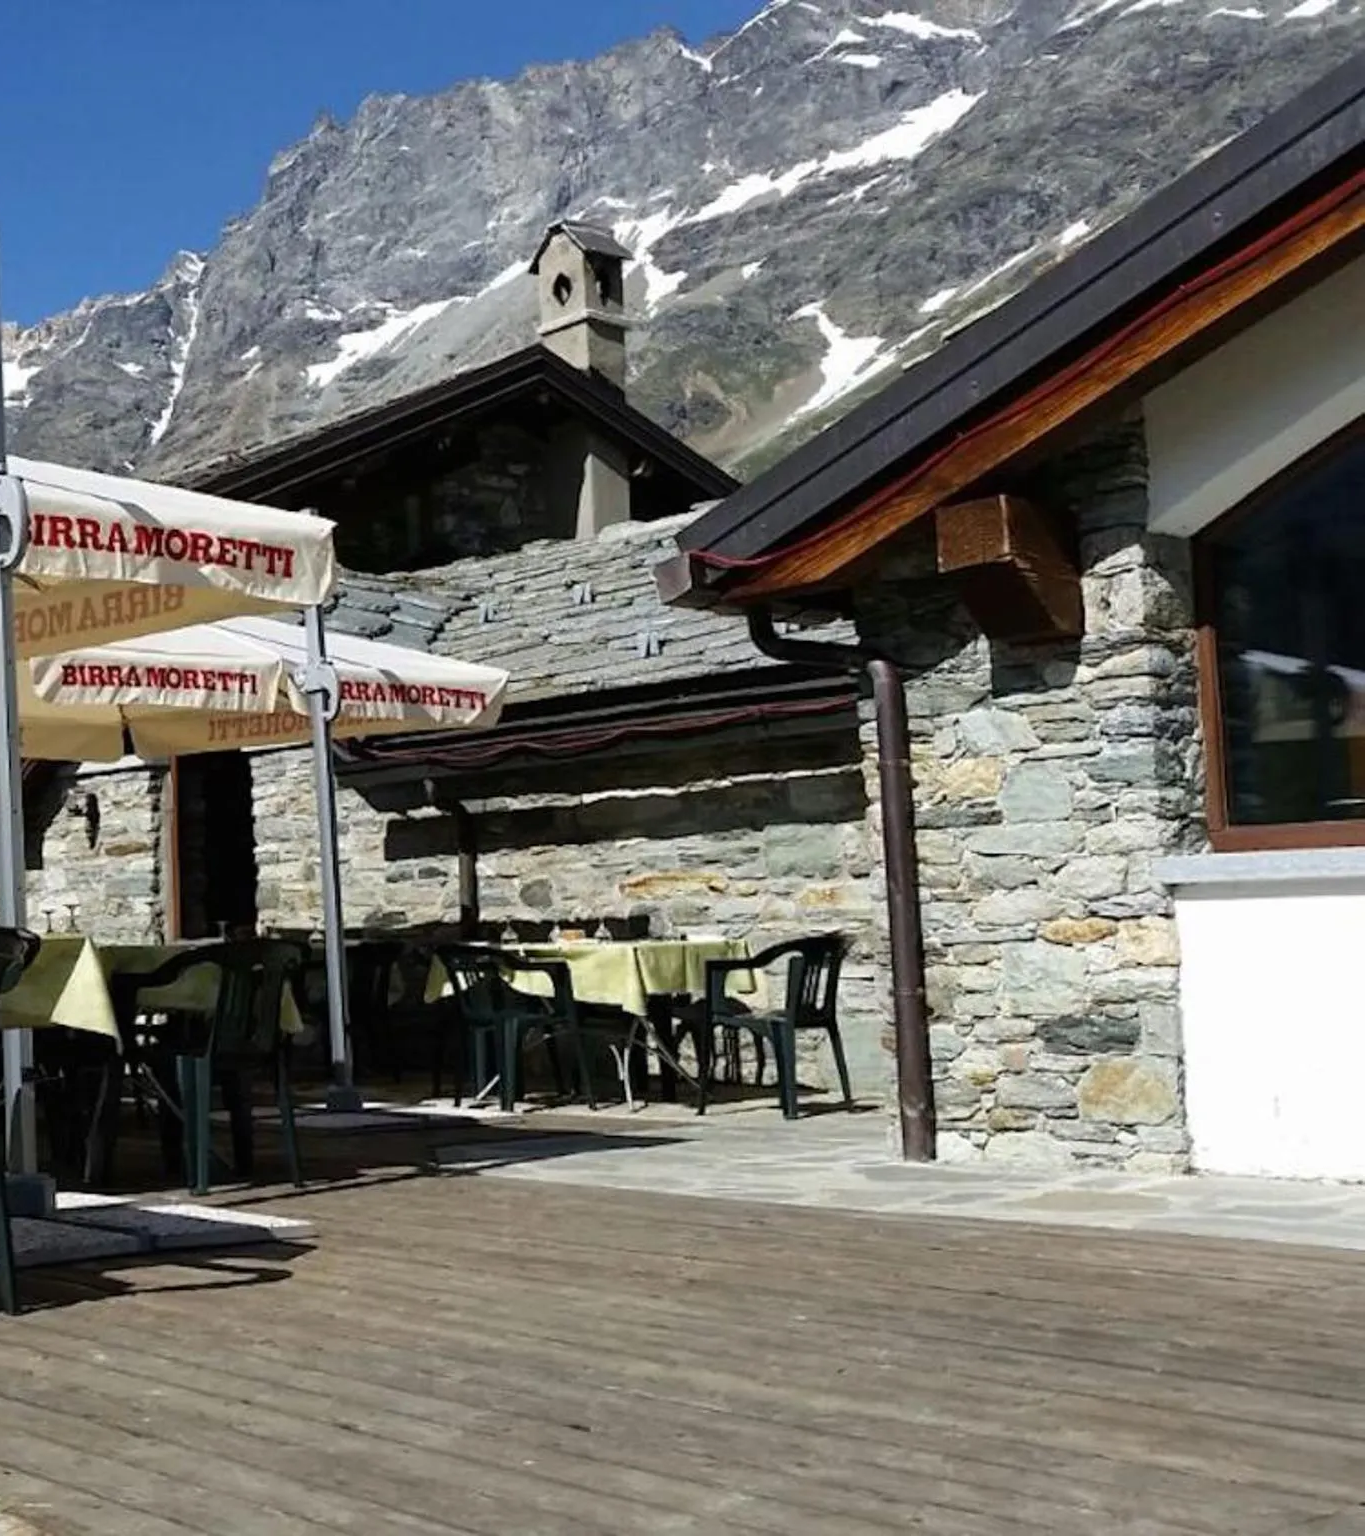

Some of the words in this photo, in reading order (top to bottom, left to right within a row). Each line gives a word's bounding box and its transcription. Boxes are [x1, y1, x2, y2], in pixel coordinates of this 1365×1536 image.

[26, 513, 129, 553] IRRA
[134, 524, 295, 578] MORETTI
[62, 664, 141, 687] BIRRA
[145, 667, 258, 695] MORETTI
[340, 681, 385, 702] RRA
[387, 683, 488, 711] MORETTI
